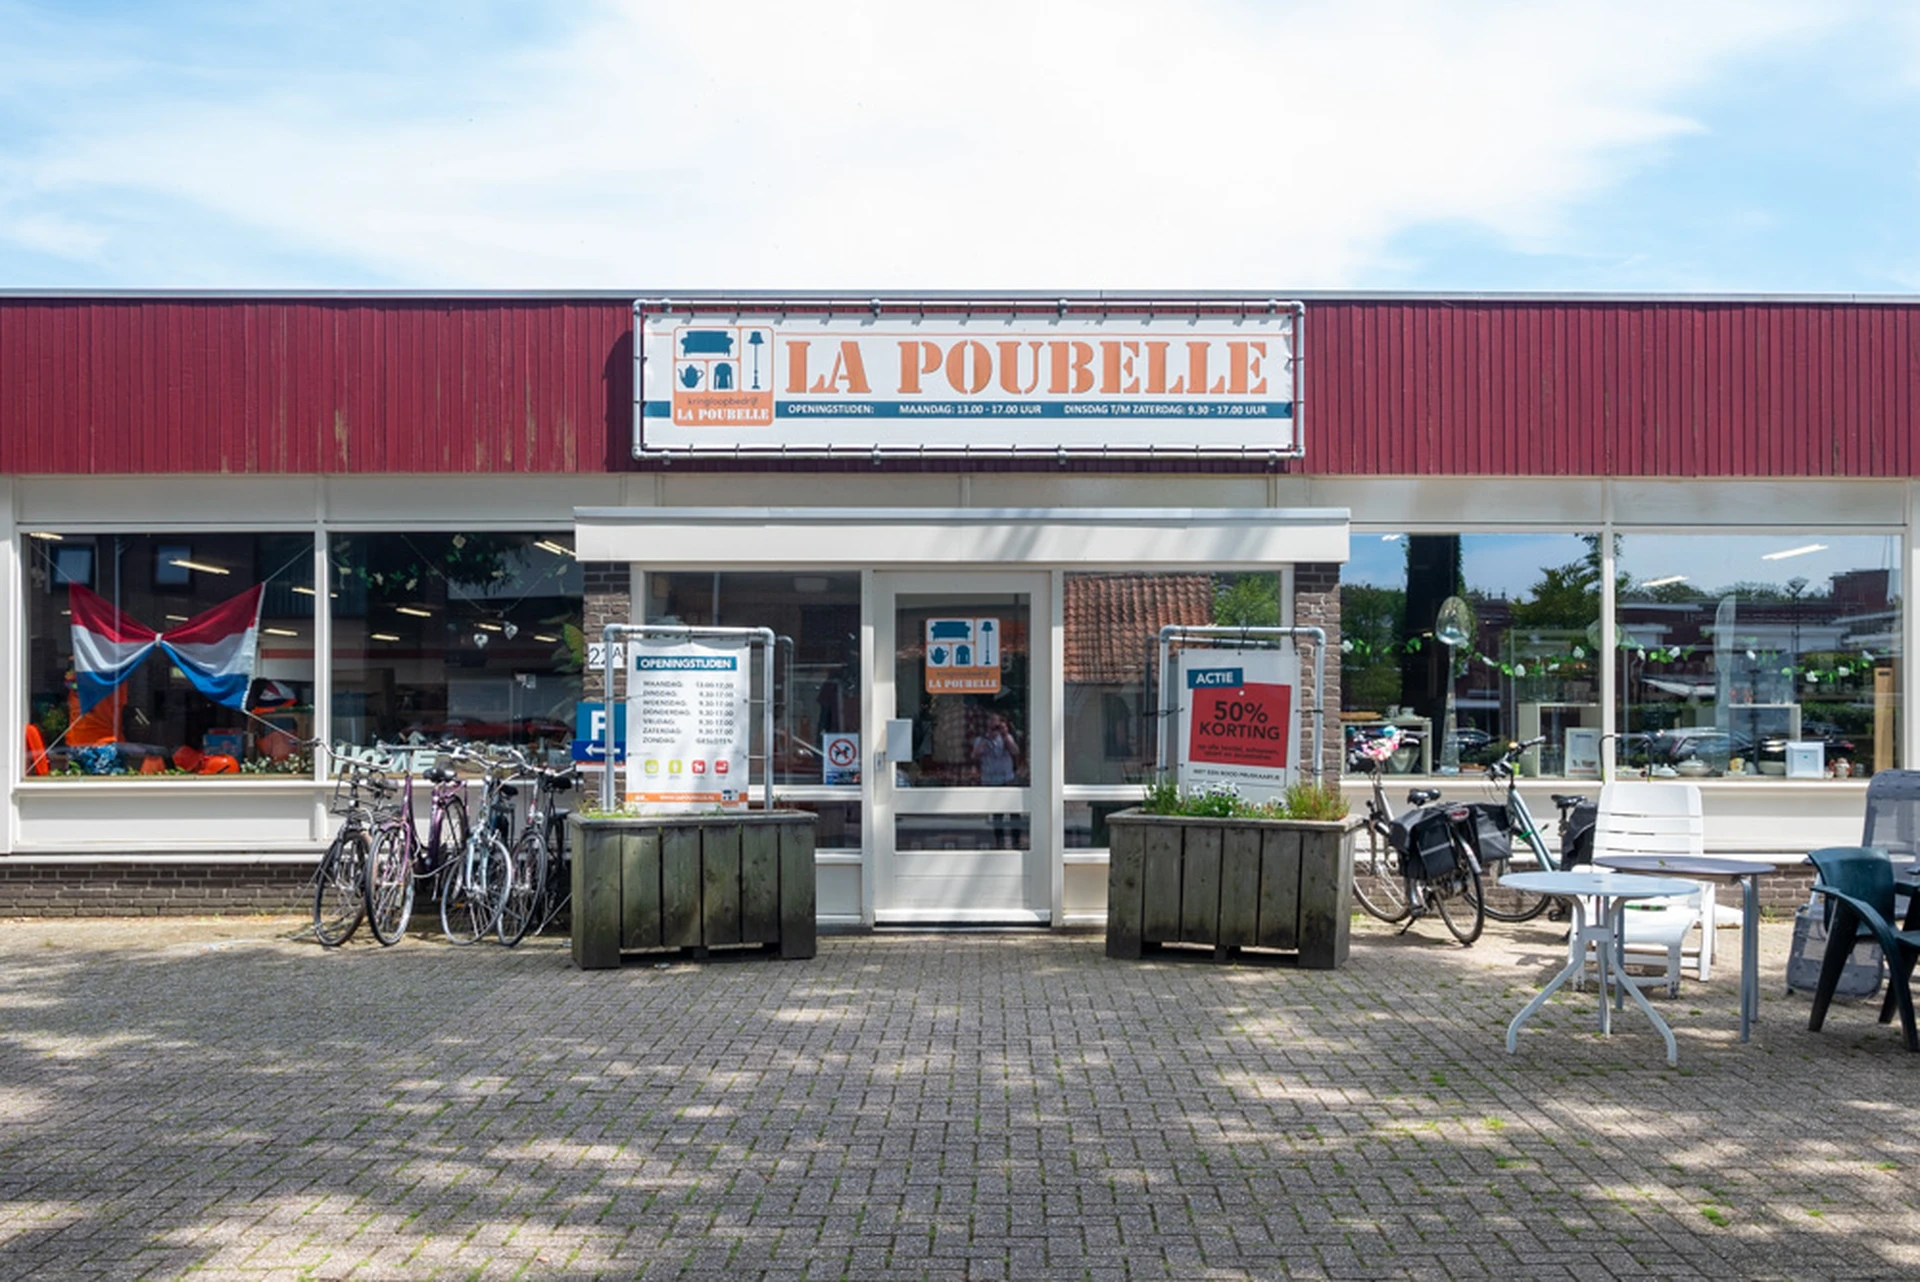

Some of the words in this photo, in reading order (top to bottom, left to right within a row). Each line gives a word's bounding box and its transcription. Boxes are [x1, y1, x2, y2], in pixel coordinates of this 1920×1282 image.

[785, 341, 872, 394] LA
[897, 340, 1267, 395] POUBELLE
[677, 408, 694, 420] LA
[698, 408, 769, 420] POUBELLE
[788, 404, 875, 415] OPENINGSTIJDEN:
[899, 404, 955, 415] MAANDAG:
[957, 404, 984, 415] 13.00
[992, 404, 1018, 415] 17.00
[1020, 404, 1042, 415] UUR
[1064, 404, 1109, 415] DINSDAG
[1110, 404, 1131, 416] T/M
[1132, 405, 1186, 416] ZATERDAG:
[1187, 405, 1209, 416] 9.30
[1217, 405, 1244, 416] 17.00
[1245, 405, 1268, 416] UUR
[928, 679, 941, 688] LA
[944, 679, 997, 688] POUBELLE
[1195, 671, 1234, 684] ACTIE
[1214, 700, 1268, 723] 50%
[1199, 722, 1280, 741] KORTING
